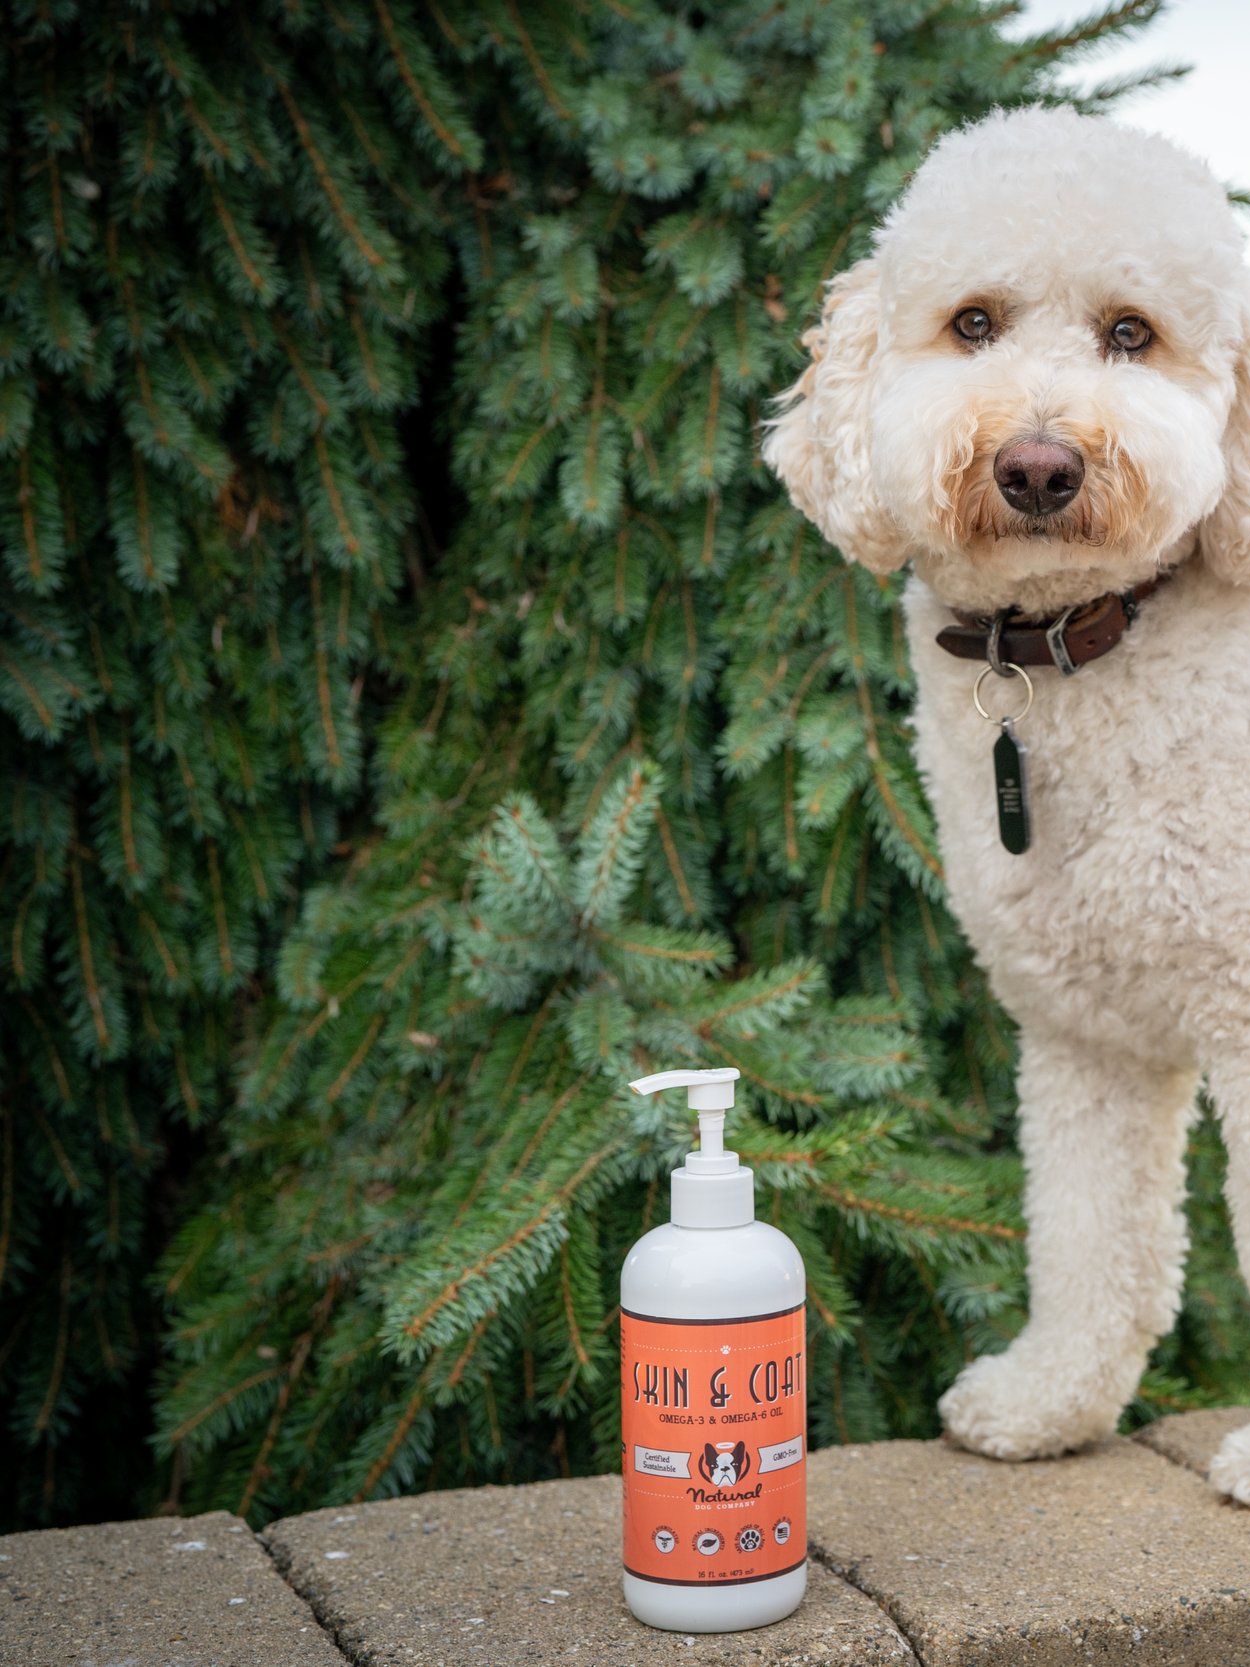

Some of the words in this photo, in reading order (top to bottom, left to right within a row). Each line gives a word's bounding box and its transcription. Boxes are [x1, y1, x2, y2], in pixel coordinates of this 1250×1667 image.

[633, 1361, 690, 1409] SKIN
[710, 1366, 732, 1408] &
[748, 1352, 802, 1405] COAT
[659, 1413, 705, 1425] OMEGA-3
[709, 1415, 717, 1425] &
[721, 1410, 767, 1425] OMEGA-6
[770, 1406, 783, 1417] OIL
[645, 1452, 670, 1463] Certified
[773, 1449, 797, 1461] GMO-Free
[643, 1460, 676, 1472] Sustainable
[686, 1483, 762, 1503] Natural
[716, 1501, 756, 1510] COMPANY
